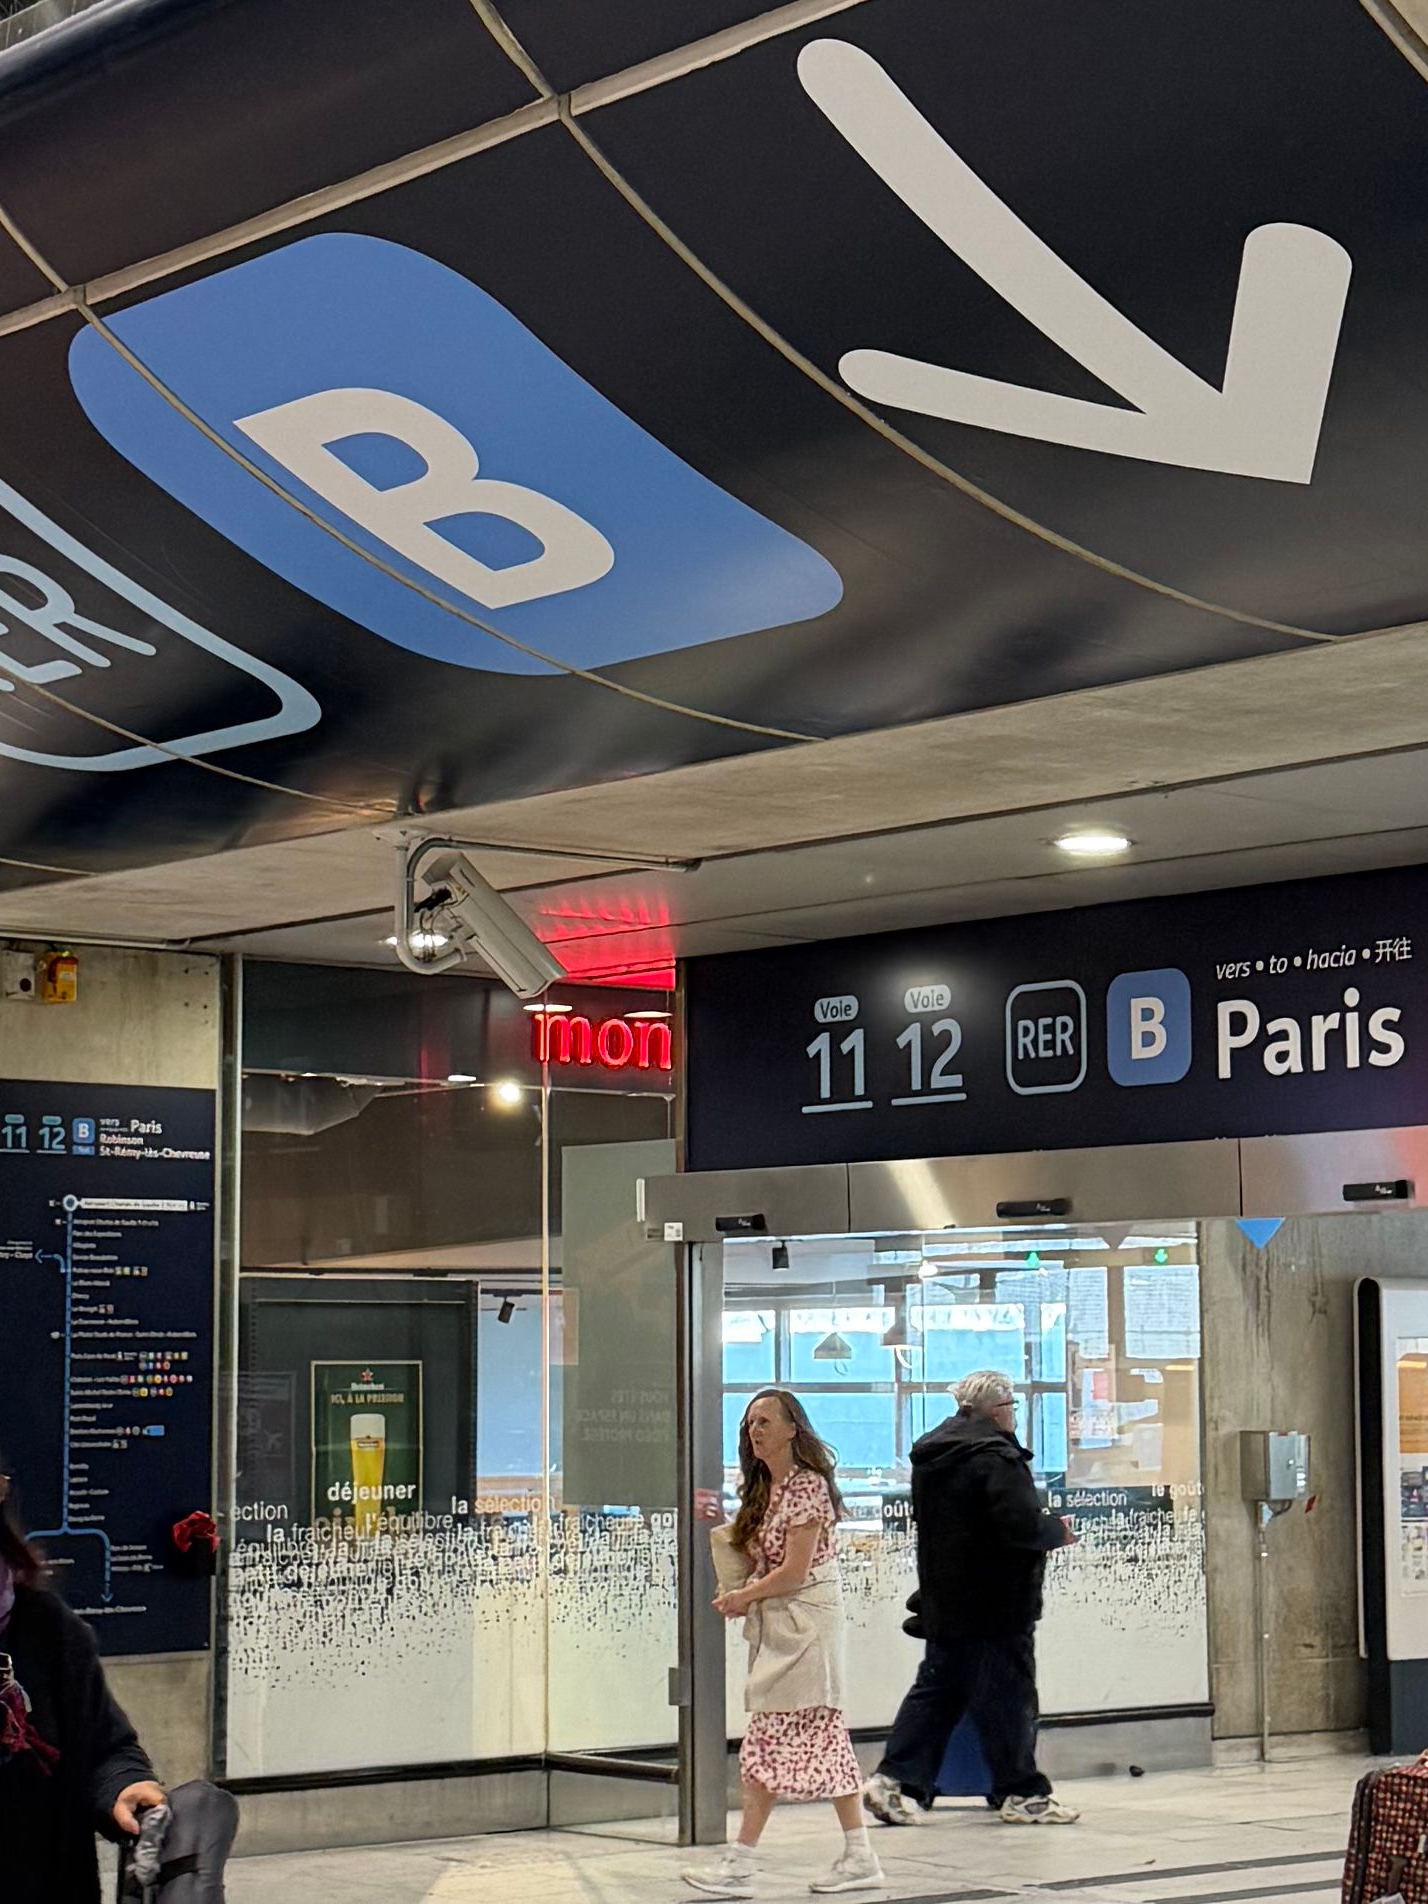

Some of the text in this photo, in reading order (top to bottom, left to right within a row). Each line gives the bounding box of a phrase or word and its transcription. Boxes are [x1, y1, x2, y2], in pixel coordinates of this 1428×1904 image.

[232, 385, 616, 609] B
[1216, 936, 1412, 980] vers to hacia 开往
[819, 989, 946, 1019] Voie Voie
[806, 987, 1405, 1099] 11 12 RER B Paris
[1, 1125, 28, 1149] 11
[38, 1126, 66, 1150] 12
[78, 1123, 90, 1138] B
[130, 1119, 163, 1135] Paris
[100, 1133, 144, 1145] Robinson
[327, 1481, 417, 1505] déjeuner
[452, 1496, 468, 1514] la
[1048, 1490, 1062, 1508] la
[232, 1501, 288, 1521] ection
[266, 1524, 285, 1543] la
